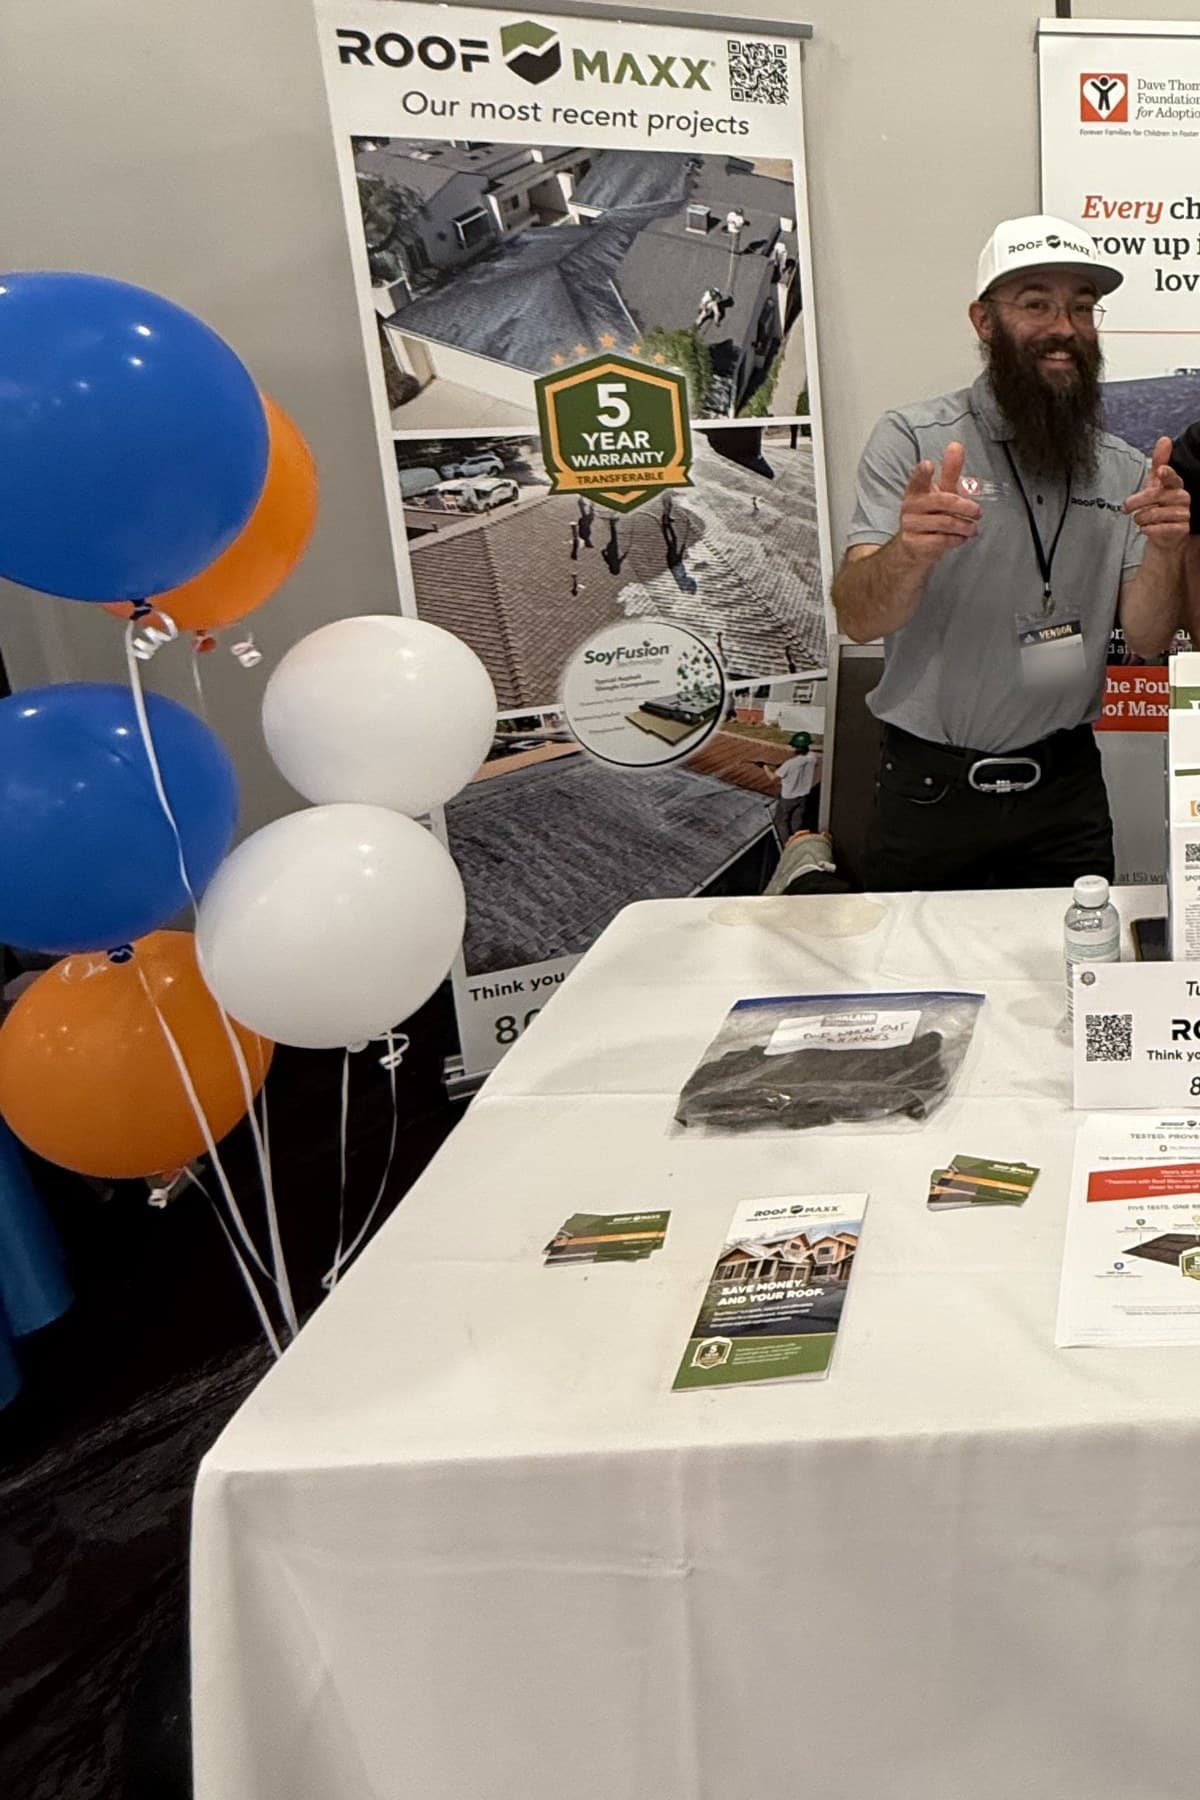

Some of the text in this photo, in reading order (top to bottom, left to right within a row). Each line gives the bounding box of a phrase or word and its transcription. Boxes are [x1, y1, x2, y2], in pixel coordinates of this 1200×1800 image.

[336, 29, 713, 91] ROOF MAXX
[1137, 79, 1166, 91] Dave
[401, 90, 750, 137] Our most recent projects
[1136, 106, 1153, 120] for
[1081, 195, 1164, 224] Every
[1008, 240, 1043, 254] ROOF
[1153, 237, 1190, 260] up
[596, 383, 631, 428] 5
[581, 431, 651, 451] YEAR
[571, 451, 665, 467] WARRANTY
[576, 471, 665, 485] TRANSFERABLE
[584, 642, 670, 665] SoyFusion
[468, 979, 525, 1001] Think
[1146, 1050, 1183, 1061] Think
[754, 1208, 787, 1217] ROOF
[721, 1279, 806, 1296] SAVE MONEY.
[717, 1289, 825, 1307] AND YOUR ROOF.
